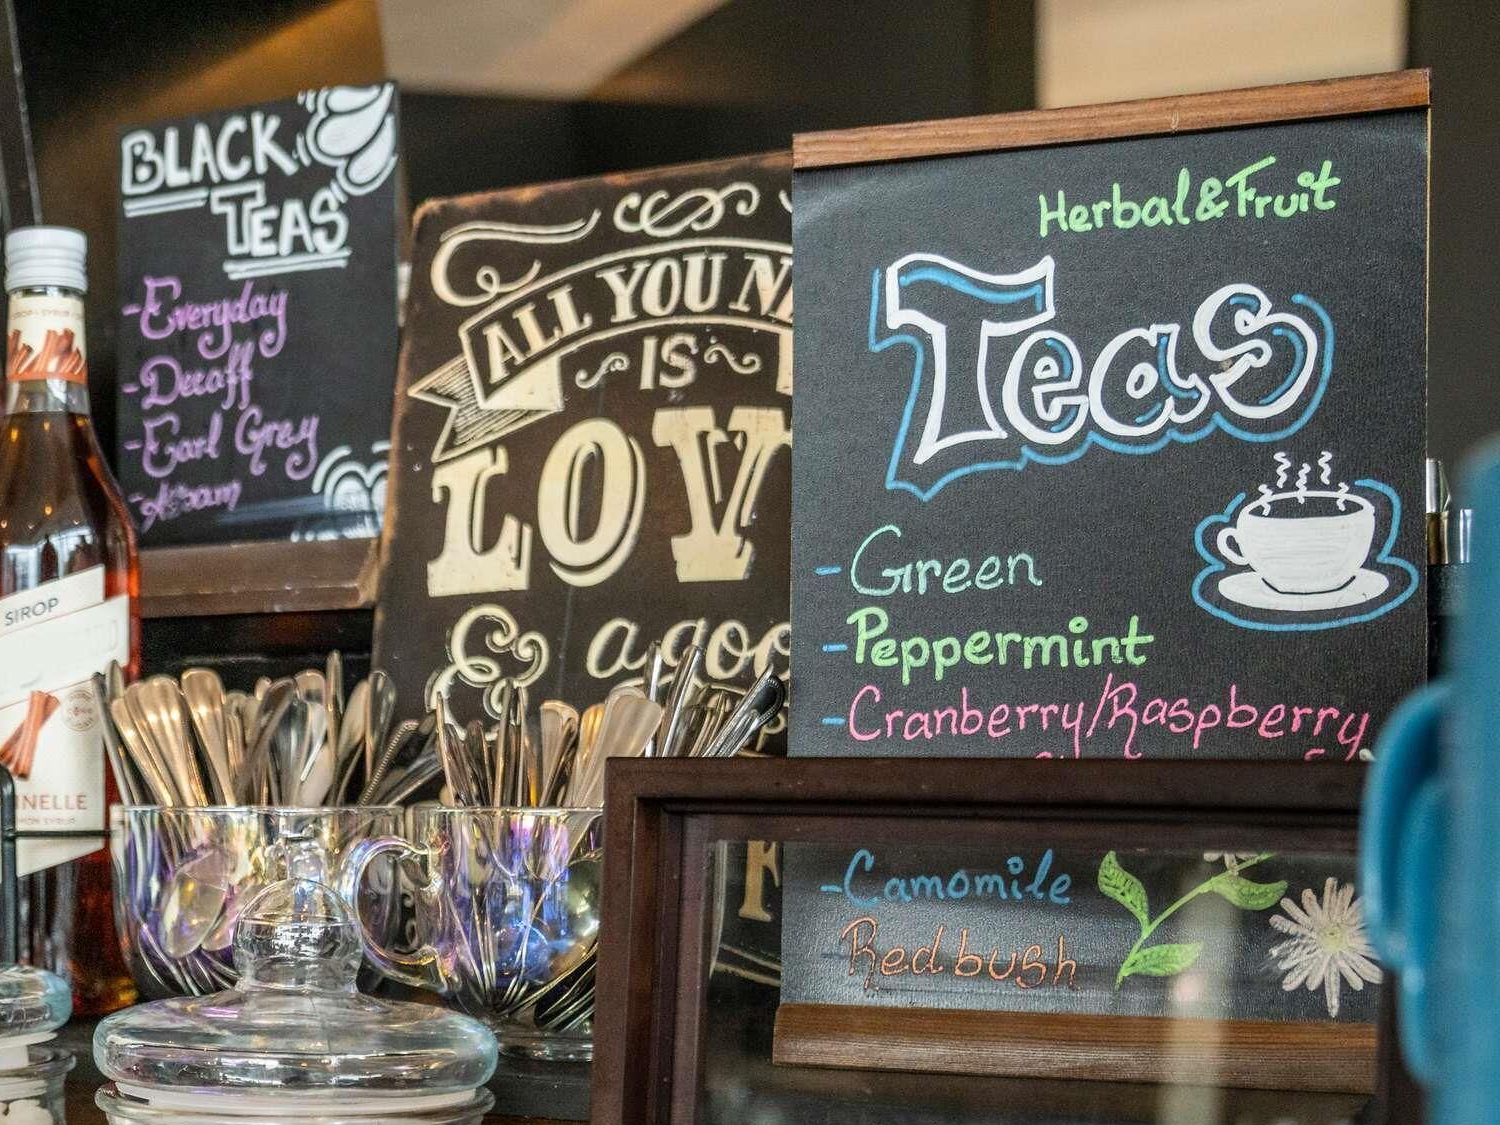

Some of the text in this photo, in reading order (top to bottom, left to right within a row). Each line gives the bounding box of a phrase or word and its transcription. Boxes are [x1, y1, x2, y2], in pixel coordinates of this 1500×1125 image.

[121, 111, 297, 195] BLACK
[210, 181, 348, 256] TEAS
[482, 285, 593, 385] ALL
[597, 253, 726, 323] YOU
[886, 252, 1318, 465] Teas
[640, 334, 697, 390] IS
[235, 404, 320, 481] Grey
[428, 406, 792, 597] LOV
[4, 597, 60, 627] SIROP
